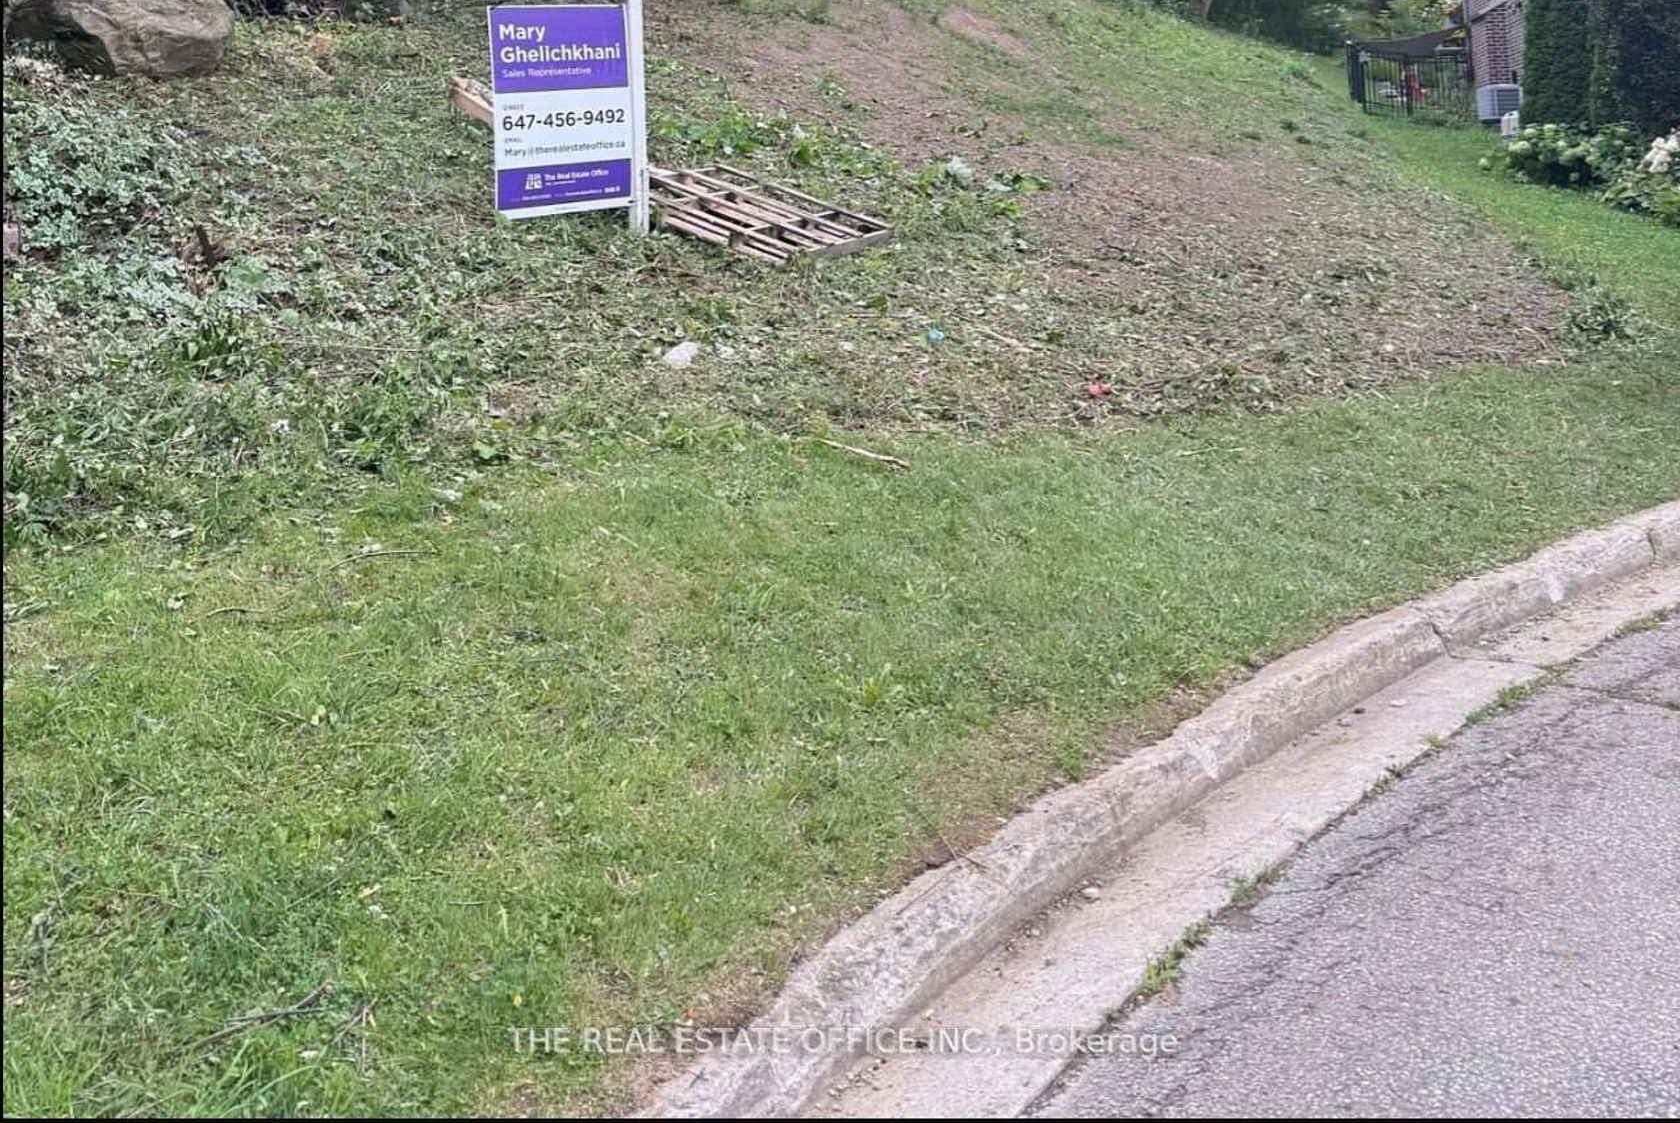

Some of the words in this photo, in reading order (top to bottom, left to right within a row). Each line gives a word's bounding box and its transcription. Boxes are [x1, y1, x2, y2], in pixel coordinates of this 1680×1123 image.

[499, 24, 546, 42] Mary
[501, 43, 621, 63] Ghelichkhani
[503, 68, 526, 78] Sales
[528, 66, 592, 77] Representative
[502, 108, 625, 131] 647-456-9492
[591, 169, 609, 177] Office
